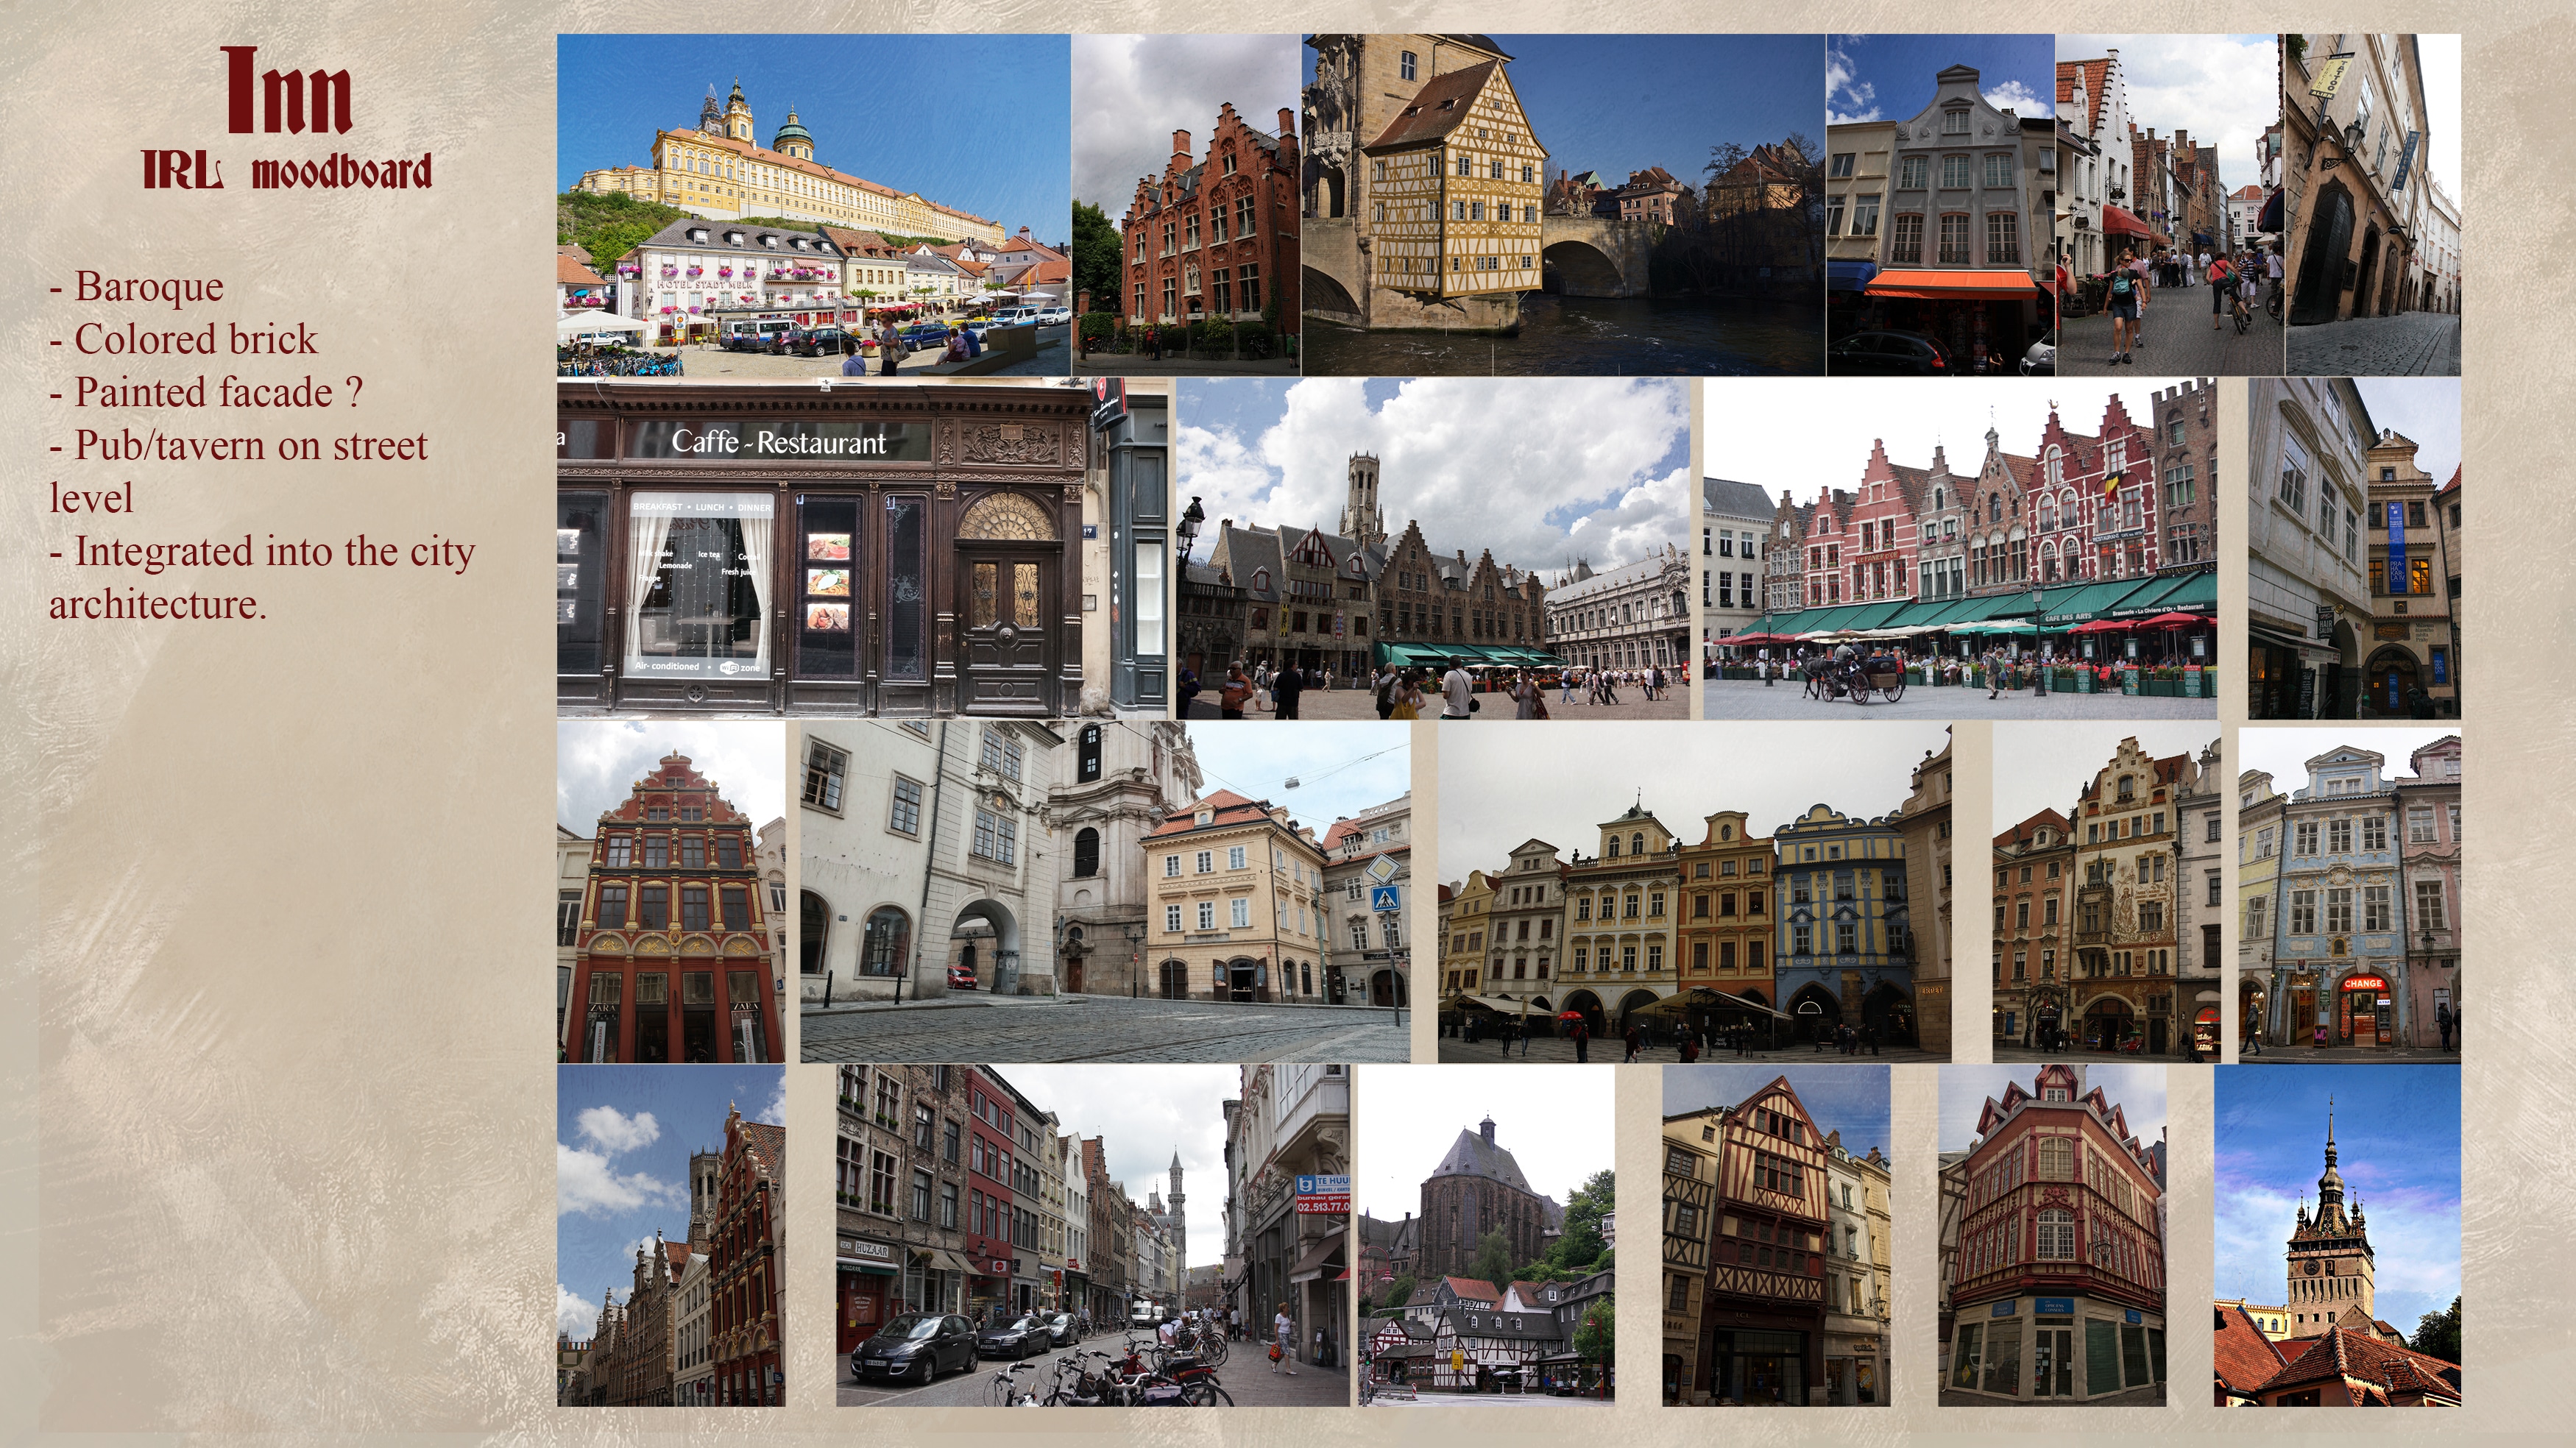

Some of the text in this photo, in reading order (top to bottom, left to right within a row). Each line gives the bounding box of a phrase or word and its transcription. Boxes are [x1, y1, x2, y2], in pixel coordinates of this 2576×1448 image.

[2327, 60, 2348, 91] TATTOO
[2396, 133, 2416, 188] RESTAURANT
[657, 280, 753, 289] HOTEL STADT MELK
[672, 429, 739, 452] Caffe
[758, 430, 887, 455] Restaurant
[2092, 533, 2120, 543] RESTAURANT
[1865, 553, 1884, 562] PANIER
[659, 561, 693, 569] Lemonade
[2158, 564, 2202, 575] RESTAURANT
[740, 569, 757, 578] juice
[651, 662, 699, 670] conditioned
[2344, 979, 2382, 987] CHANGE
[1922, 986, 1943, 994] ERPET
[590, 1004, 616, 1012] ZARA
[734, 1002, 759, 1010] ZARA
[2340, 997, 2350, 1038] change
[2314, 1029, 2326, 1040] WC
[1298, 1202, 1350, 1212] 02.513.77.0
[856, 1243, 888, 1257] HUZAAR
